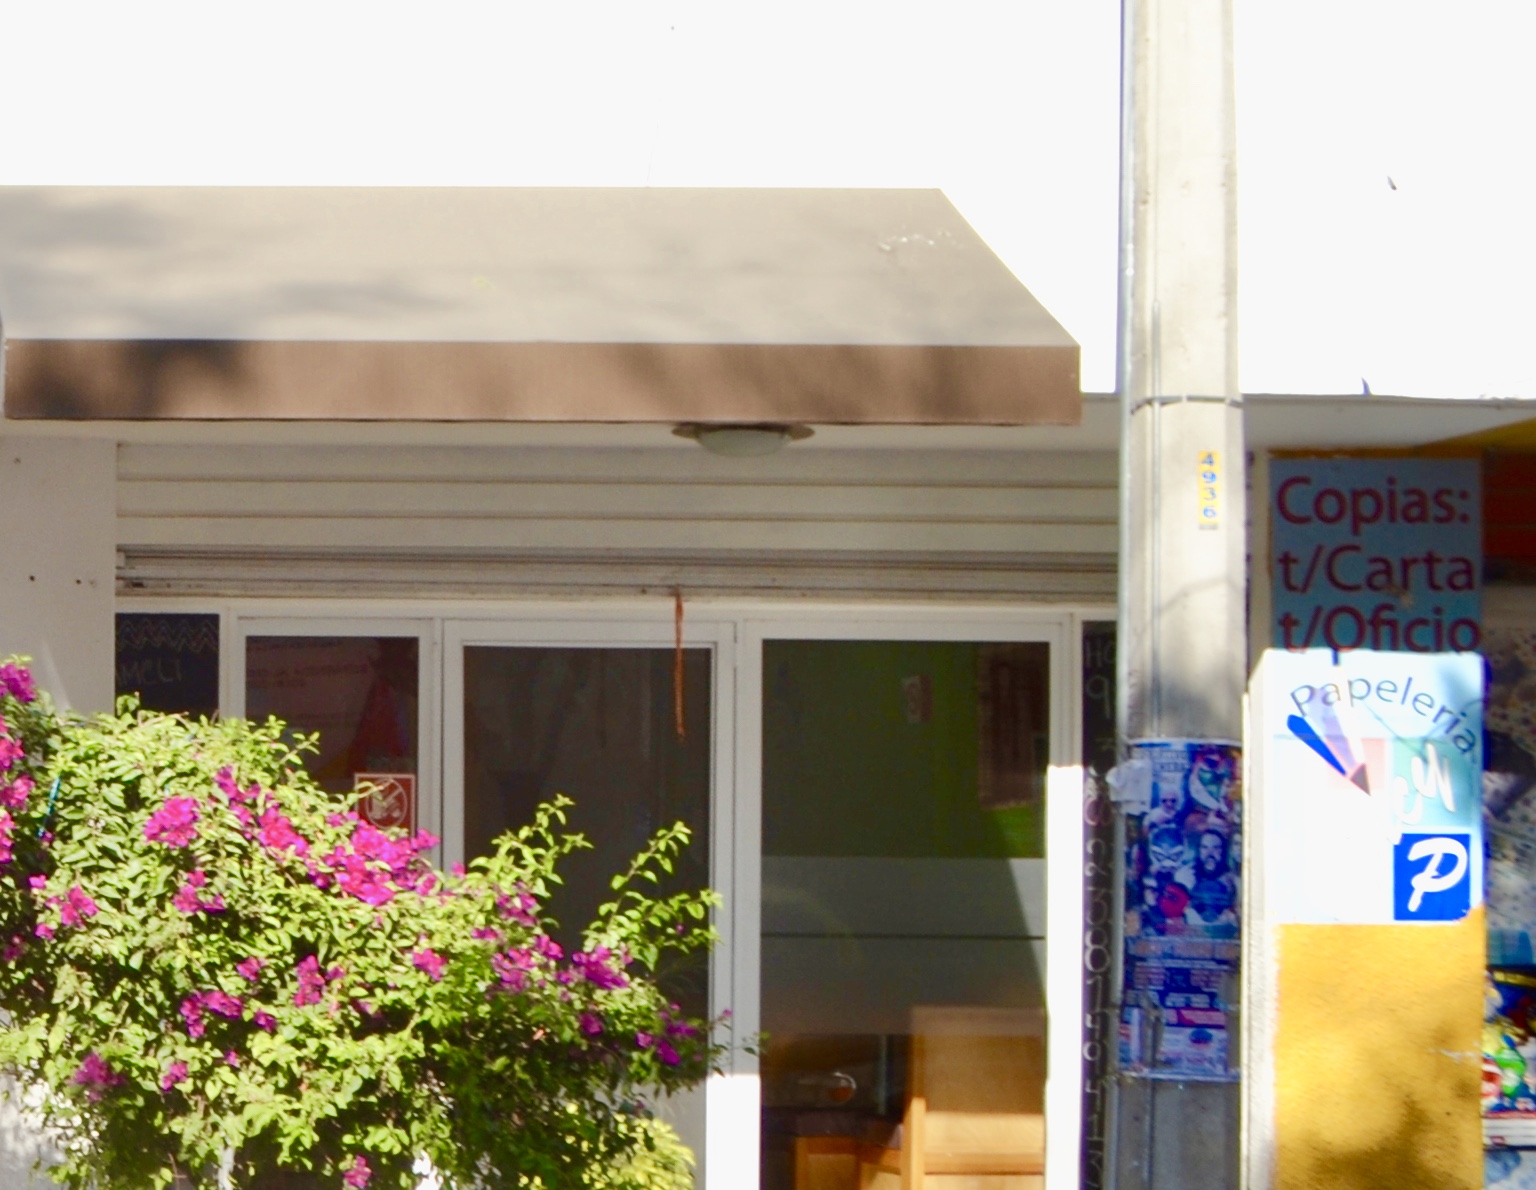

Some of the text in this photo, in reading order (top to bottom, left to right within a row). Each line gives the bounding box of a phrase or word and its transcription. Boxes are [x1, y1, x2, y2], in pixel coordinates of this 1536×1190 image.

[1276, 476, 1471, 535] Copias:
[1278, 544, 1476, 594] t/Carta
[1278, 603, 1481, 653] t/Oficio
